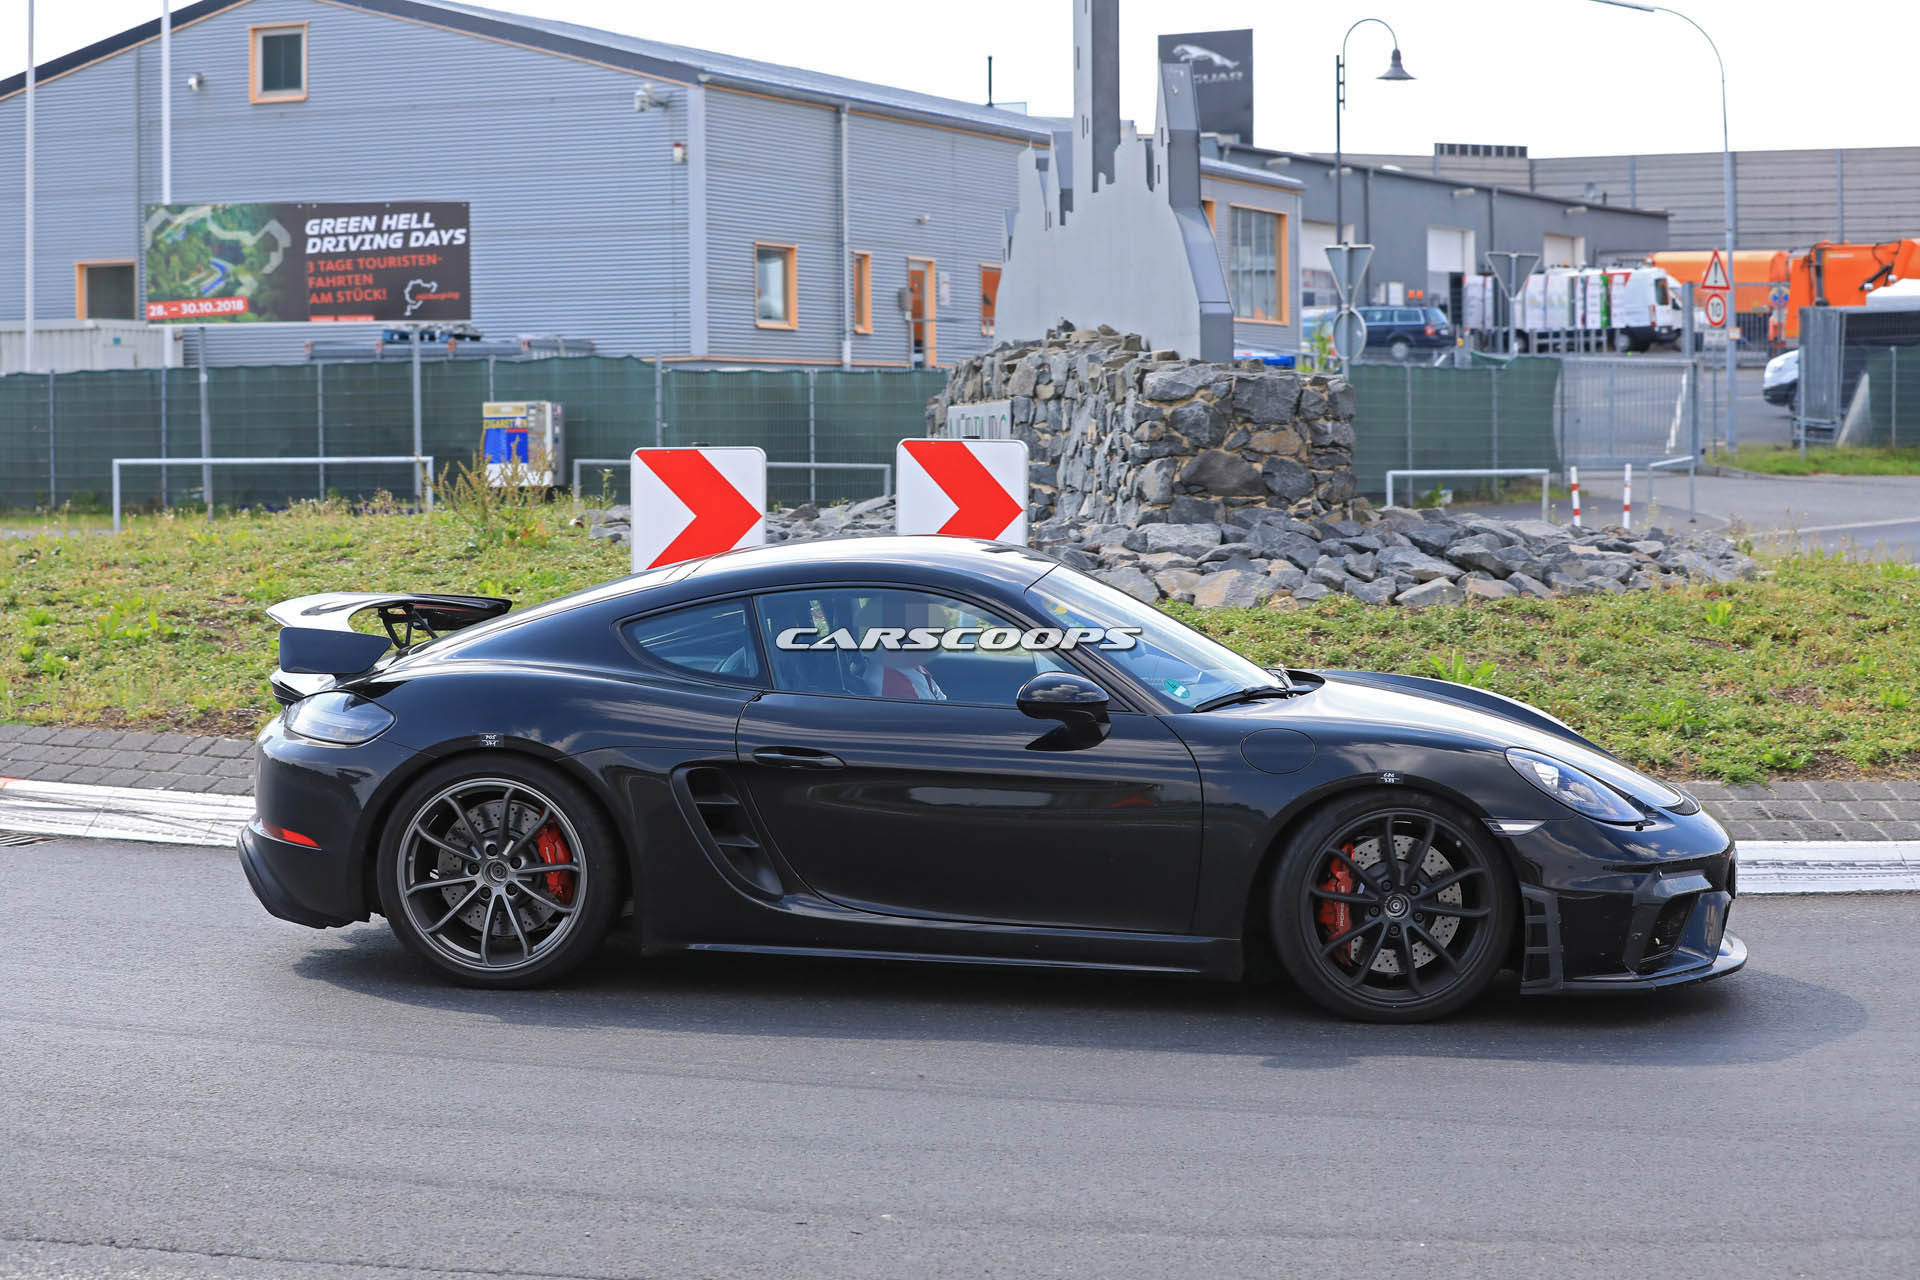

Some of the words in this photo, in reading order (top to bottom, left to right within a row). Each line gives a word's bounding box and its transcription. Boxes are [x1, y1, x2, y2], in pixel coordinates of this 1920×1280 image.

[305, 215, 377, 236] GREEN
[381, 212, 435, 231] HELL
[305, 232, 404, 254] DRIVING
[408, 228, 467, 248] DAYS
[307, 261, 315, 273] 3
[317, 258, 353, 272] TAGE
[356, 253, 443, 271] TOURISTEN-
[308, 273, 374, 288] FAHRTEN
[309, 291, 334, 304] AM
[336, 287, 388, 303] STÜCK!
[149, 304, 168, 316] 28.
[181, 299, 244, 315] 30.10.2018
